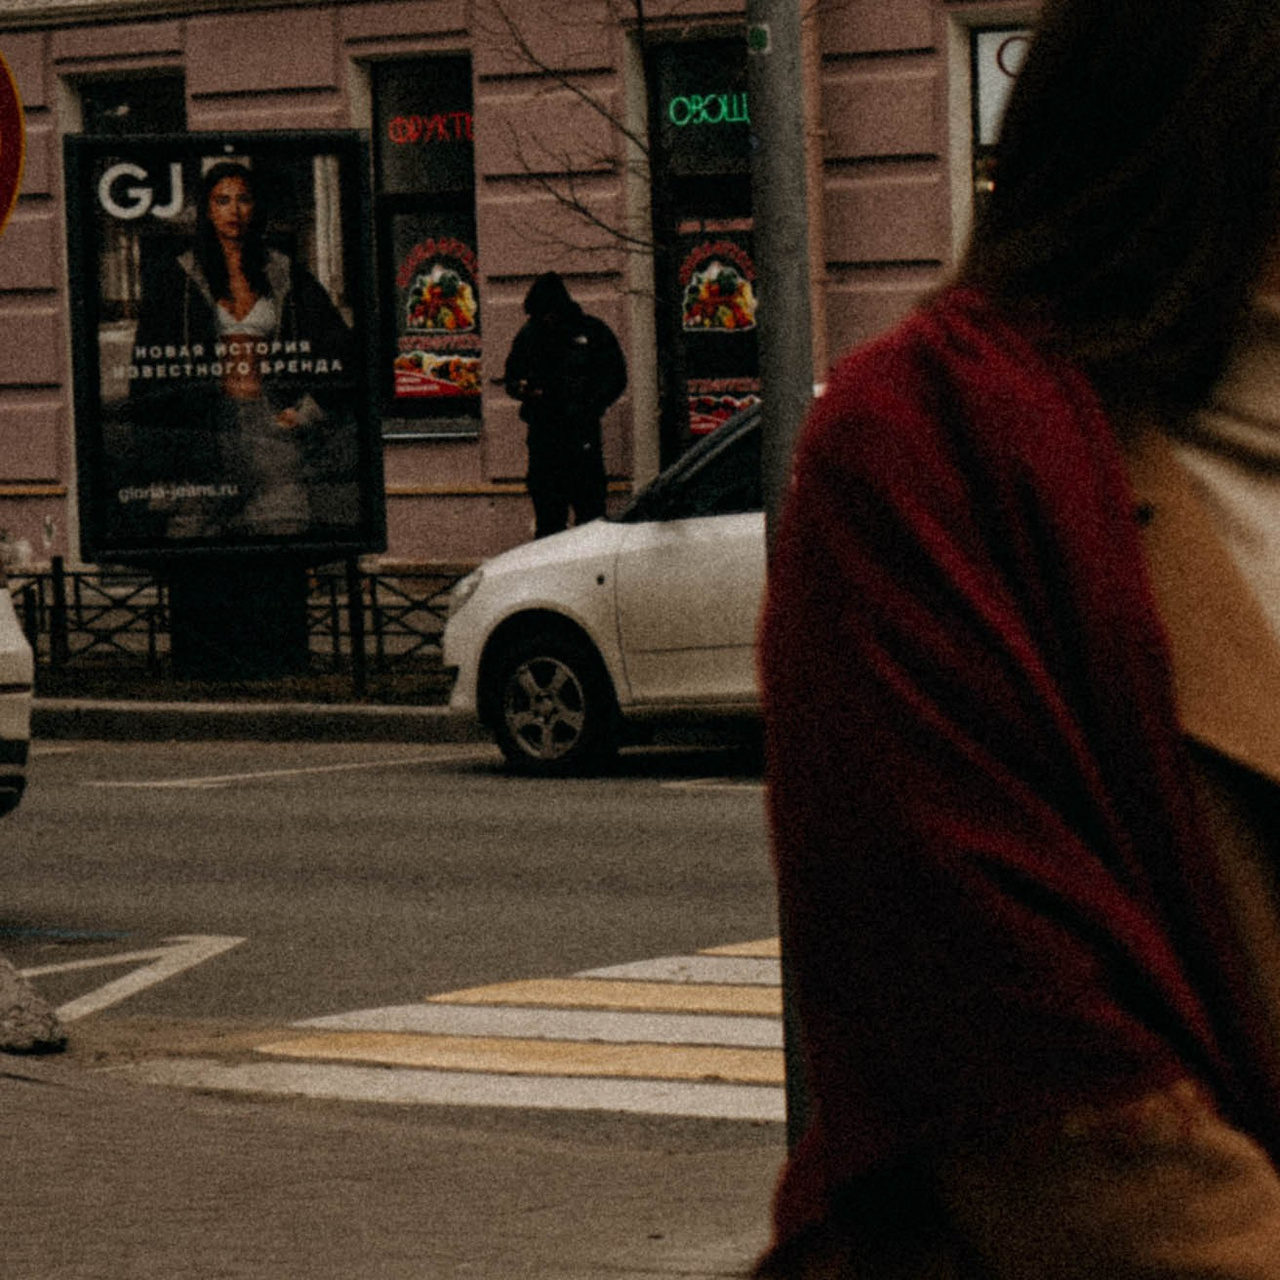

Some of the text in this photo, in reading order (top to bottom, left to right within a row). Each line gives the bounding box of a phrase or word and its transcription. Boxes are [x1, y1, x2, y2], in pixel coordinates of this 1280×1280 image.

[97, 161, 183, 220] GJ
[135, 339, 312, 359] НОВАЯ ИСТОРИЯ
[260, 358, 344, 375] БРЕНДА
